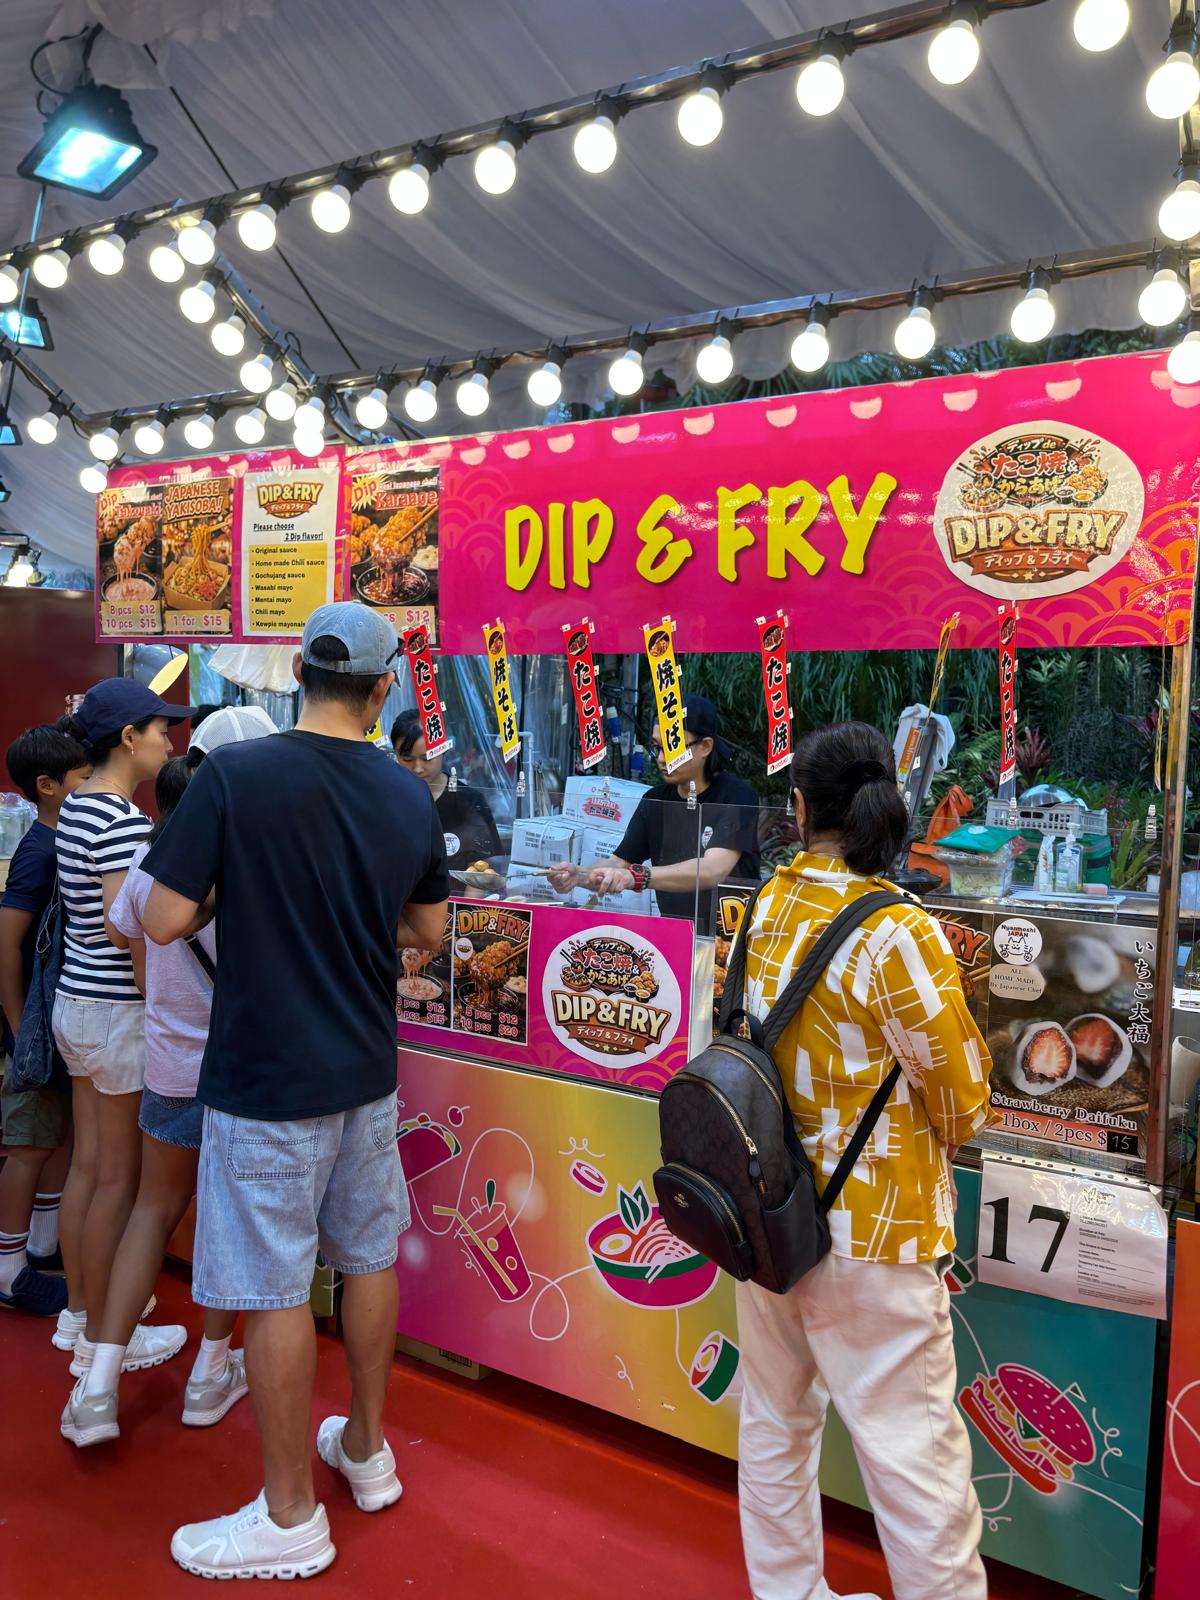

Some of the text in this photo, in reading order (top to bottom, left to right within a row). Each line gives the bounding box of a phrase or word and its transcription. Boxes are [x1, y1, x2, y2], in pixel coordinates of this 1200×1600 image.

[1042, 439, 1057, 450] de
[991, 450, 1079, 479] たこ焼 &
[164, 479, 220, 503] JAPANESE
[257, 482, 323, 507] DIP&FRY
[353, 480, 377, 502] Dip
[997, 475, 1064, 495] からあげ
[165, 495, 224, 521] YAKISOBA!
[375, 490, 438, 510] Karaage
[253, 522, 295, 531] Please choose
[290, 532, 301, 541] Dip
[504, 471, 898, 591] DIP & FRY
[948, 511, 1125, 557] DIP&FRY
[255, 547, 278, 555] Original
[255, 572, 286, 580] Gochujang
[110, 604, 156, 616] 8 pcs $12
[181, 615, 196, 626] for
[203, 614, 223, 626] $15
[406, 609, 430, 623] $12
[106, 618, 157, 629] 10 pcs $15
[414, 658, 444, 744] たこ焼
[493, 657, 515, 744] 焼そば
[573, 659, 602, 752] たこ焼
[656, 658, 682, 753] 焼そば
[765, 655, 788, 758] たこ焼
[457, 909, 532, 942] DIP&FRY
[1007, 930, 1029, 938] JAPAN
[617, 944, 626, 952] de
[582, 948, 640, 975] たこ焼 &
[587, 969, 631, 986] からあげ
[994, 974, 1035, 985] HOME MADE
[999, 983, 1026, 992] Japanese
[1126, 939, 1155, 1045] いちご大福
[404, 999, 420, 1009] pcs
[426, 1000, 445, 1014] $12
[474, 1008, 492, 1020] pcs
[498, 1010, 518, 1025] $12
[553, 992, 669, 1039] DIP&FRY
[404, 1010, 420, 1020] pcs
[426, 1012, 445, 1025] $15
[460, 1016, 518, 1037] 10 pcs $20
[613, 1031, 636, 1045] フライ
[991, 1091, 1138, 1131] Strawberry Daifuku
[1002, 1112, 1041, 1134] 1box
[1054, 1123, 1093, 1144] 2pcs
[981, 1196, 1071, 1274] 17
